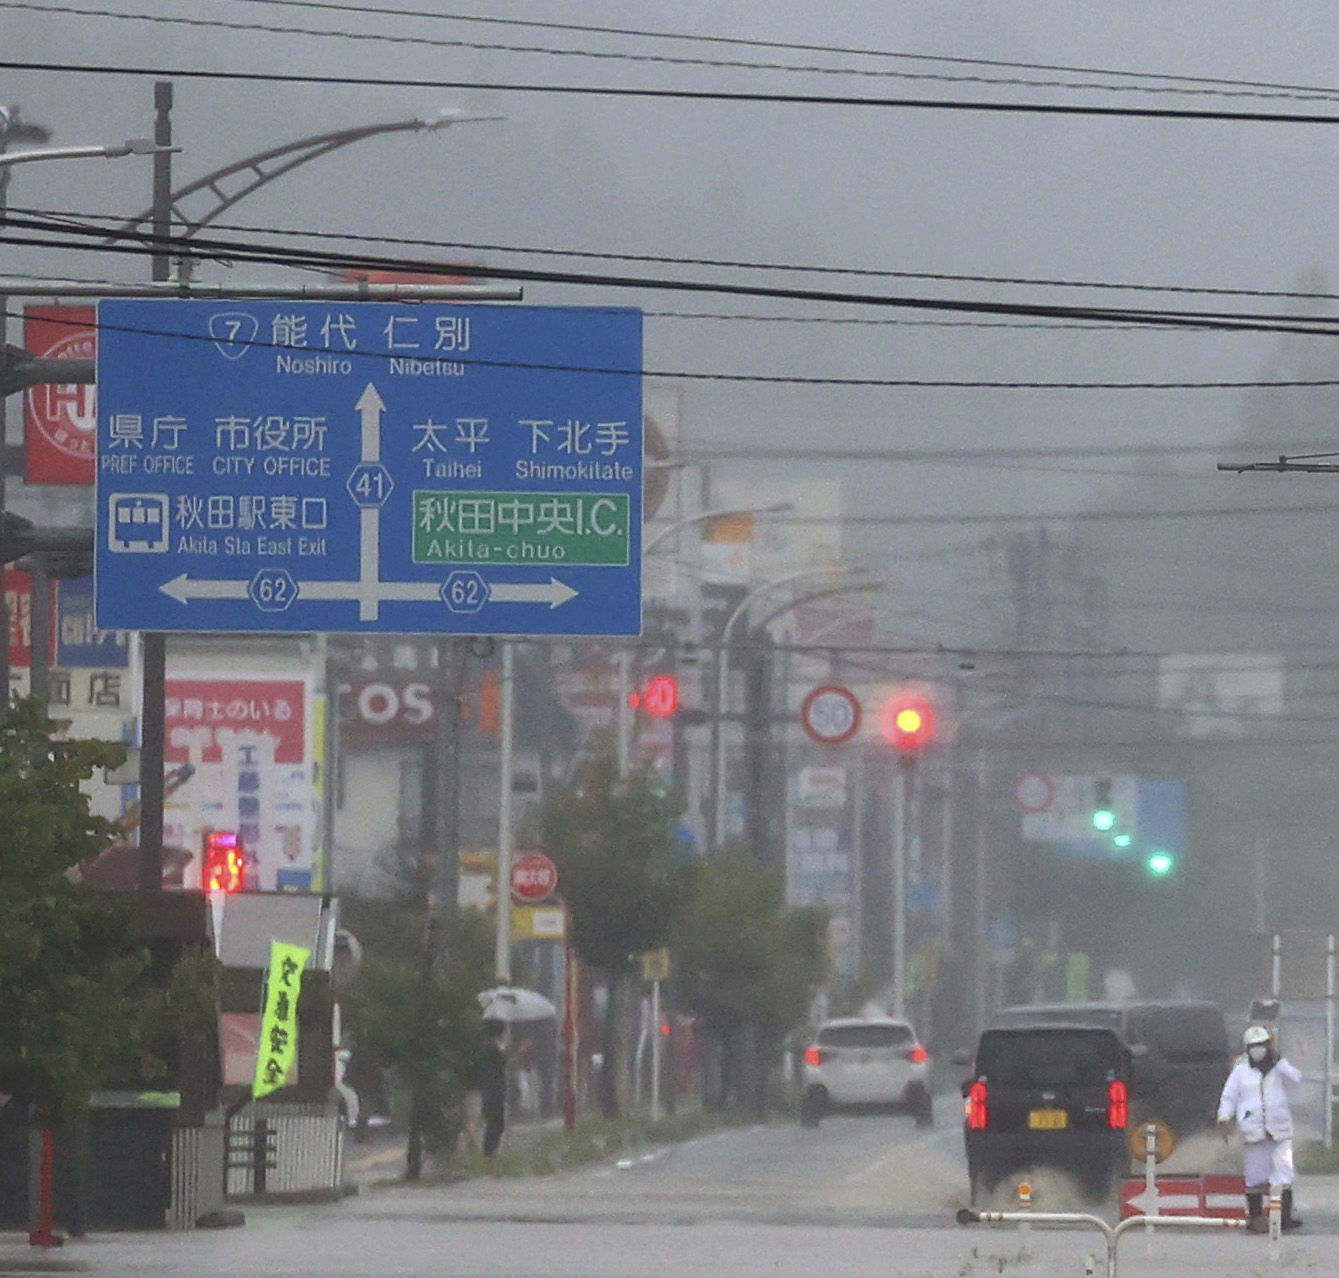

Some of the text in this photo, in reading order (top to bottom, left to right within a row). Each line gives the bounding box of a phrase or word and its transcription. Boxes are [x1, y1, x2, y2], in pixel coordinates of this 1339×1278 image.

[225, 321, 241, 345] 7
[271, 313, 470, 350] 能代 仁別
[276, 355, 465, 376] Noshiro Nibetsu
[108, 414, 188, 450] 県庁
[215, 415, 328, 451] 市役所
[411, 418, 630, 456] 太平 下北手
[102, 454, 331, 477] PREF OFFICE CITY OFFICE
[424, 458, 634, 481] Taihei Shimokitate
[356, 473, 384, 499] 41
[176, 494, 328, 531] 秋田駅東口
[418, 497, 622, 536] 秋田中央I.C.
[177, 536, 326, 557] Akita Sta East Exit
[427, 539, 566, 560] Akita-chuo
[260, 578, 287, 602] 62
[452, 580, 479, 605] 62
